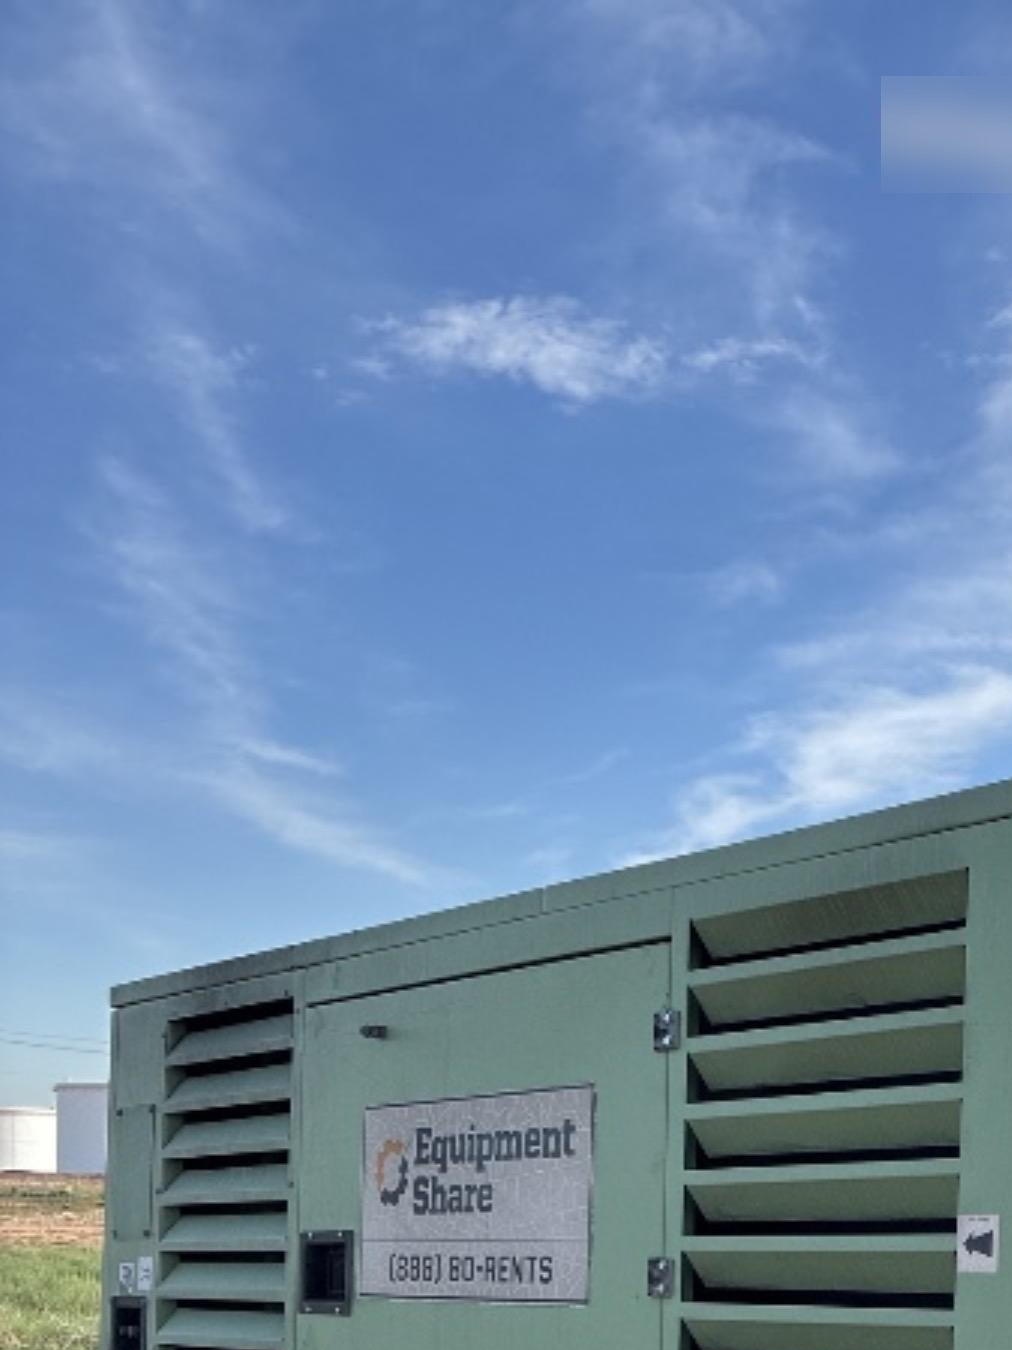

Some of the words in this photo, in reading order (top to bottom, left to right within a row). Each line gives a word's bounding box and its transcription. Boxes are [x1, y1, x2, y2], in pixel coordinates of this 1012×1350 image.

[412, 1117, 576, 1174] Equipment
[412, 1175, 494, 1216] Share
[448, 1256, 554, 1285] 80-RENTS
